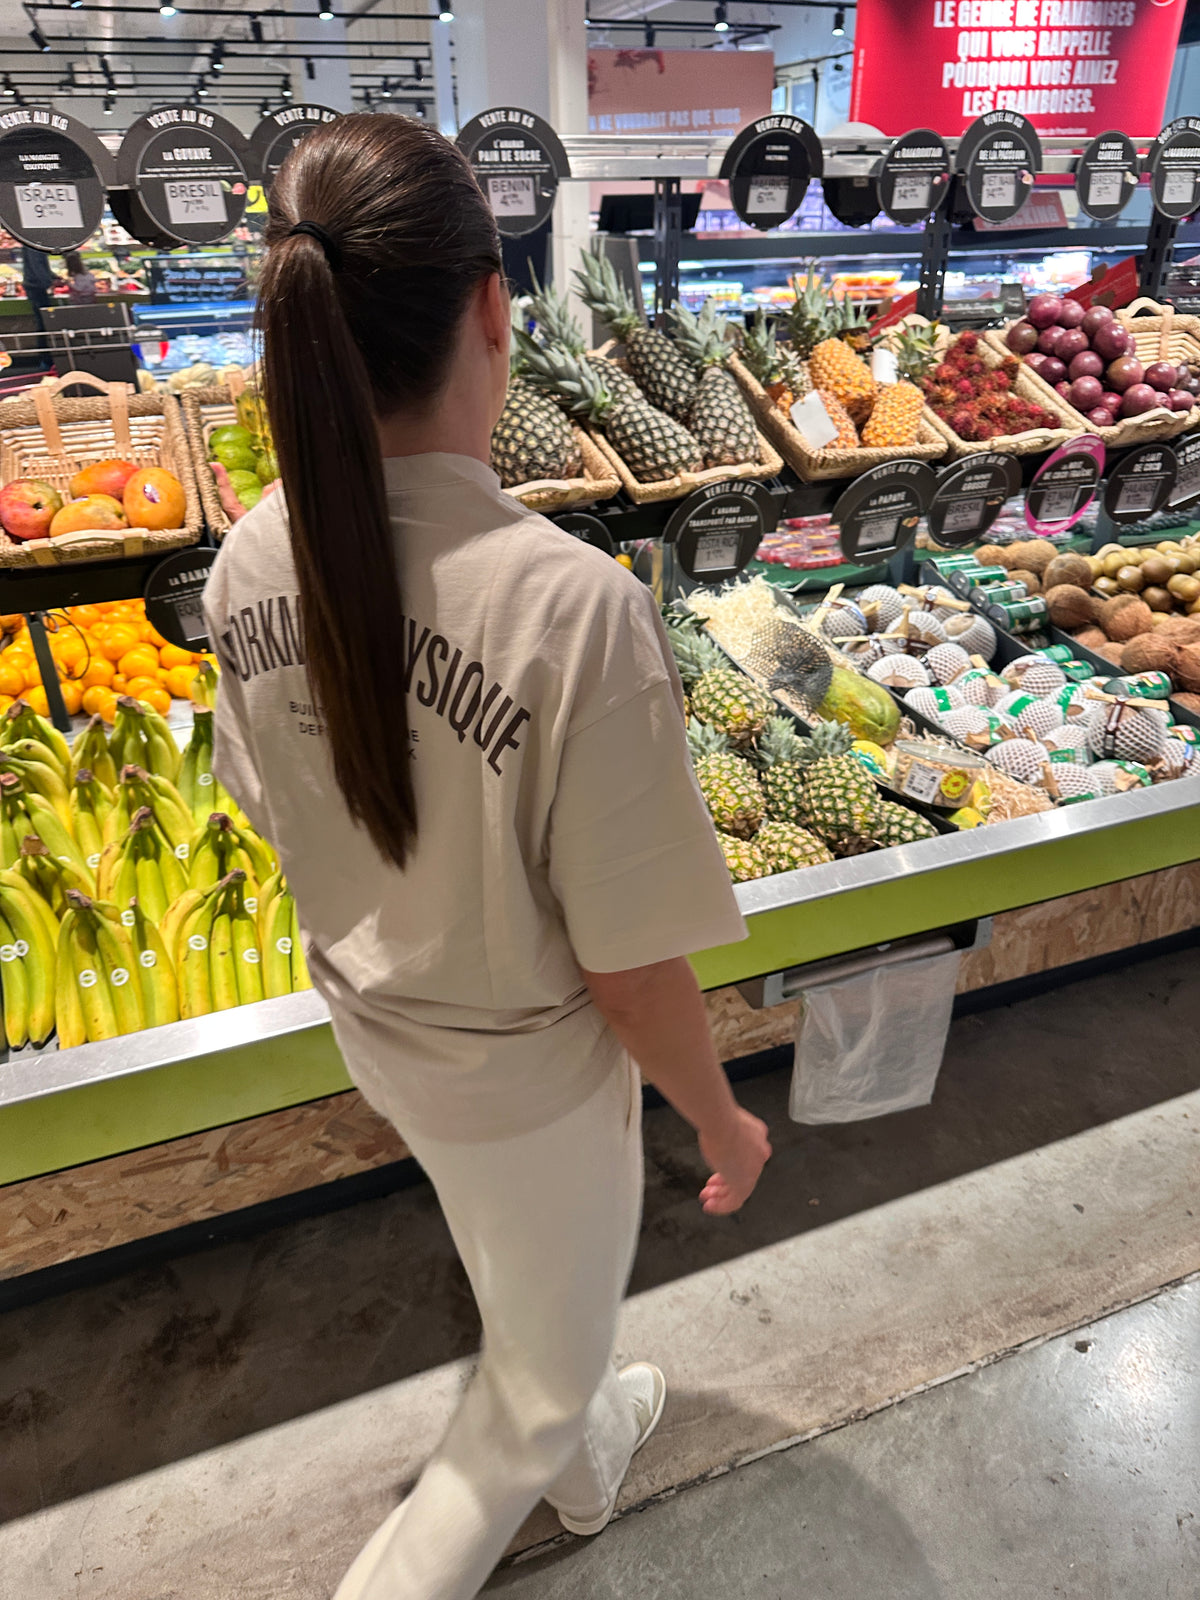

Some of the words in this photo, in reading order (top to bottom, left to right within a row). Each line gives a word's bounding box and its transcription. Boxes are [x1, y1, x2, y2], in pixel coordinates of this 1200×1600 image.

[934, 1, 955, 27] LE
[958, 0, 1014, 27] GENRE
[1015, 0, 1038, 27] DE
[1040, 1, 1136, 27] FRAMBOISES
[957, 31, 989, 62] QUI
[991, 31, 1036, 57] VOUS
[1037, 31, 1112, 56] RAPPELLE
[942, 60, 1028, 91] POURQUOI
[1030, 60, 1072, 86] VOUS
[1072, 60, 1119, 85] AIMEZ
[962, 91, 994, 117] LES
[996, 89, 1095, 115] FRAMBOISES.
[33, 111, 49, 124] AU
[51, 115, 69, 131] KG
[147, 110, 180, 128] VENTE
[181, 110, 196, 123] AU
[198, 113, 214, 128] KG
[273, 108, 304, 126] VENTE
[306, 108, 320, 120] AU
[479, 111, 507, 128] VENTE
[508, 111, 520, 123] AU
[522, 114, 535, 128] KG
[669, 110, 689, 127] PAS
[692, 109, 711, 128] QUE
[713, 107, 741, 124] VOUS
[755, 118, 780, 133] VENTE
[478, 150, 499, 161] PAIN
[501, 150, 512, 161] DE
[514, 150, 541, 161] SUCRE
[20, 188, 75, 202] ISRAEL
[169, 185, 219, 198] BRESIL
[492, 181, 530, 193] BENIN
[872, 464, 897, 480] VENTE
[704, 483, 731, 498] VENTE
[731, 482, 744, 493] AU
[743, 486, 757, 496] KG
[169, 578, 180, 586] LA
